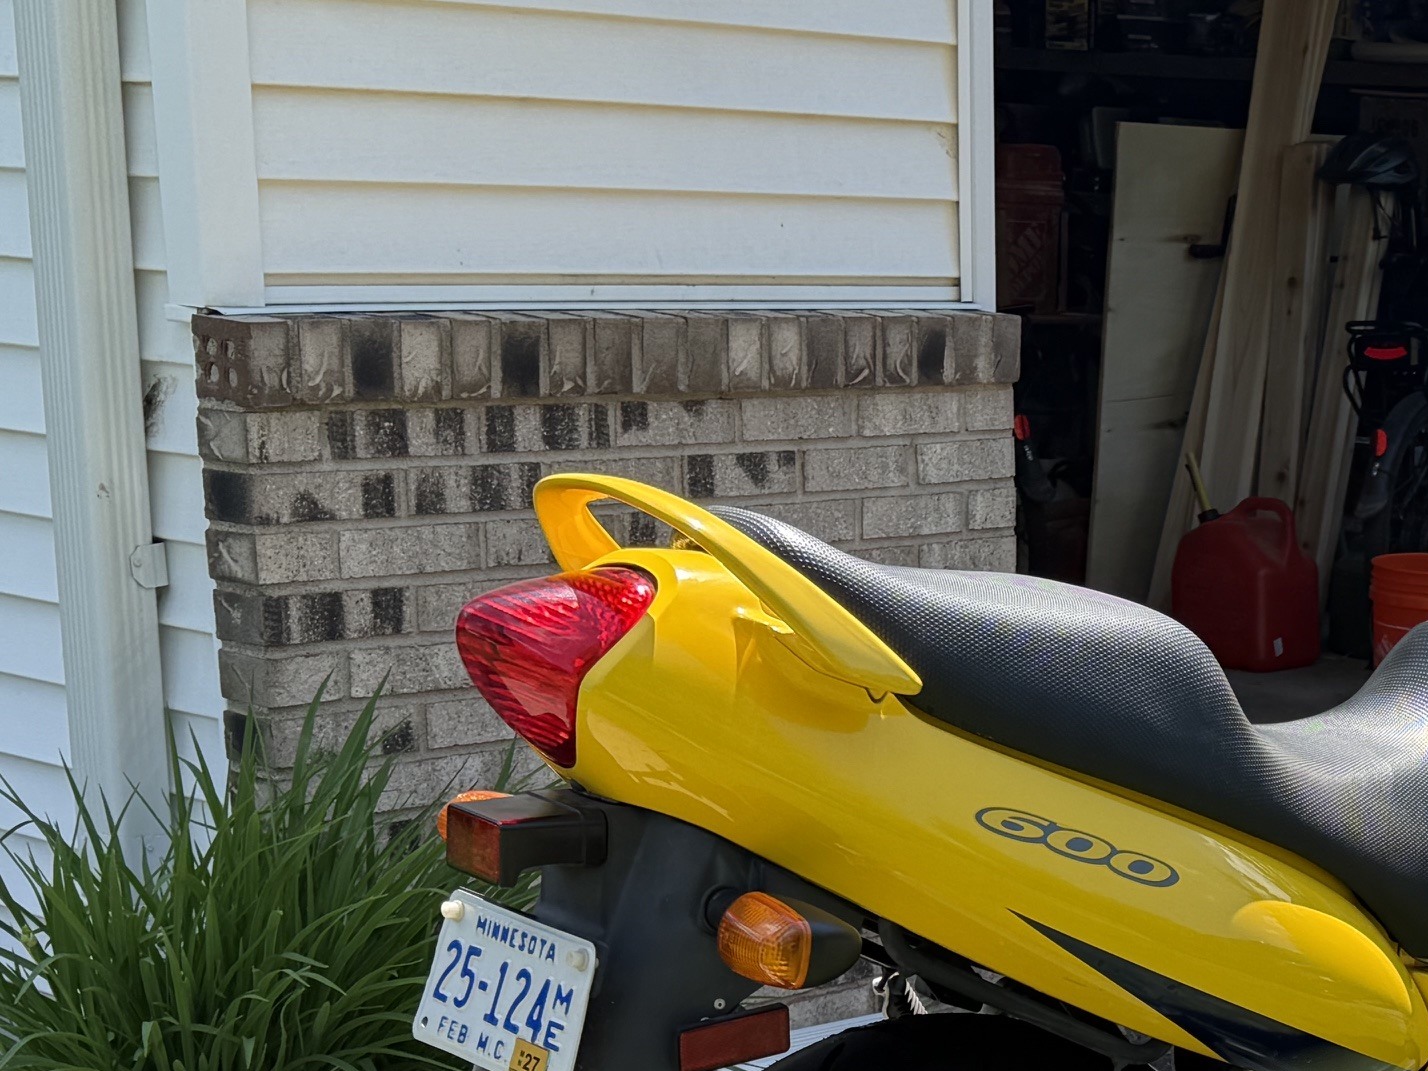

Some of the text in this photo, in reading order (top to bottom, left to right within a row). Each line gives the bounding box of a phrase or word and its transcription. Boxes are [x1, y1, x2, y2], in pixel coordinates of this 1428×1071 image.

[974, 806, 1180, 888] 600
[475, 915, 556, 963] MINNESOTA
[433, 939, 551, 1044] 25-124
[437, 1016, 469, 1044] FEB
